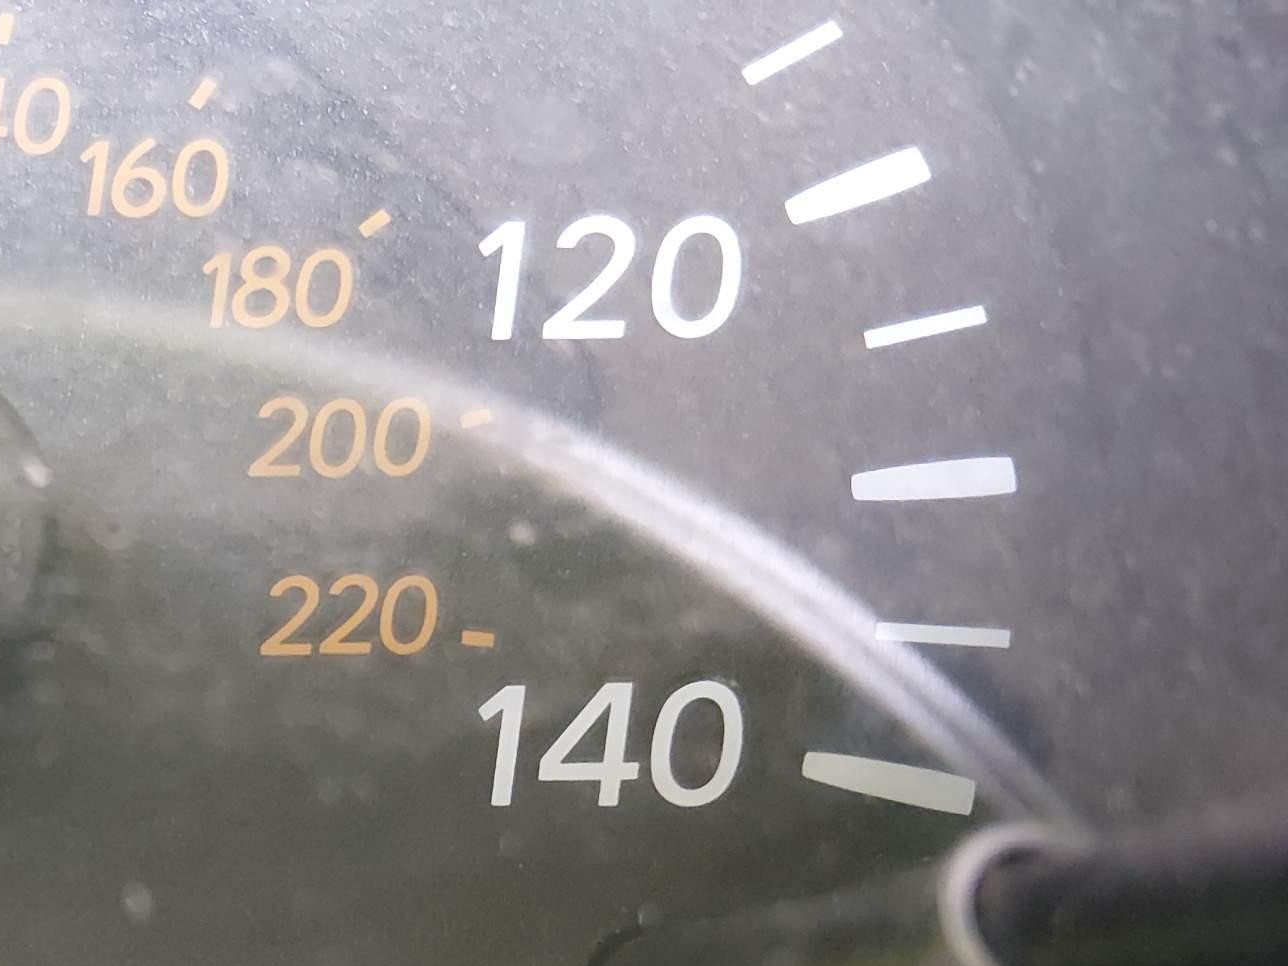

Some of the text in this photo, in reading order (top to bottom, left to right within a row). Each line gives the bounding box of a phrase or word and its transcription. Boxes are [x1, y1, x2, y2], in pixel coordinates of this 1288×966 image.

[81, 138, 230, 218] 160
[202, 246, 355, 329] 180
[478, 214, 743, 342] 120
[247, 398, 432, 479] 200
[259, 573, 439, 657] 220
[477, 679, 744, 809] 140
